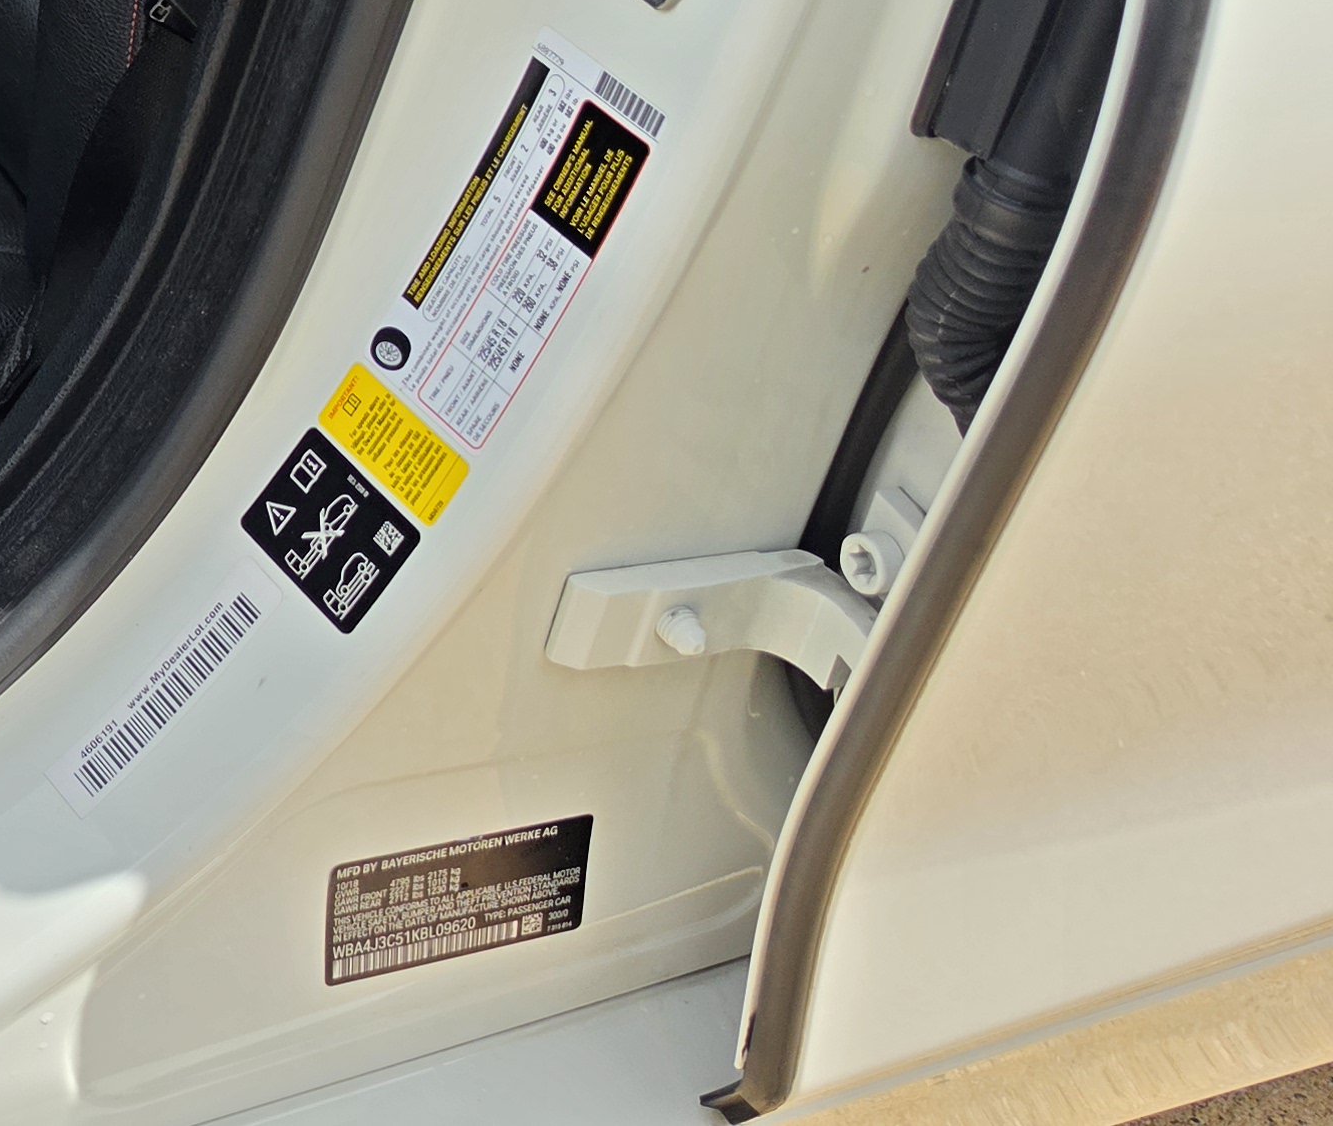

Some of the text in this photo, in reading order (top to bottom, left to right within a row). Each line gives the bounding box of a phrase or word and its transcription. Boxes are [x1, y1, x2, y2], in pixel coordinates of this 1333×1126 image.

[548, 88, 556, 96] 3
[520, 144, 528, 152] 2
[544, 190, 555, 206] SEE
[570, 117, 594, 154] MANUAL
[597, 170, 614, 194] POUR
[609, 148, 625, 171] PLUS
[453, 218, 465, 236] SUR
[462, 204, 473, 219] LES
[485, 168, 493, 179] ET
[490, 156, 500, 168] LE
[551, 146, 590, 212] FOR ADDITIONAL
[558, 162, 592, 218] INFORMATION
[569, 206, 583, 227] VOIR
[580, 195, 589, 207] LE
[603, 148, 614, 162] DE
[584, 226, 594, 239] DE
[417, 260, 430, 279] AND
[533, 309, 549, 331] NONE
[555, 270, 571, 292] NONE
[127, 602, 223, 709] www.MyDealerLot.com
[80, 719, 118, 759] 4606191
[337, 825, 557, 878] MFD BY BAYERISCHE MOTOREN WERKE AG
[332, 916, 475, 959] WBA4J3C51KBL09620
